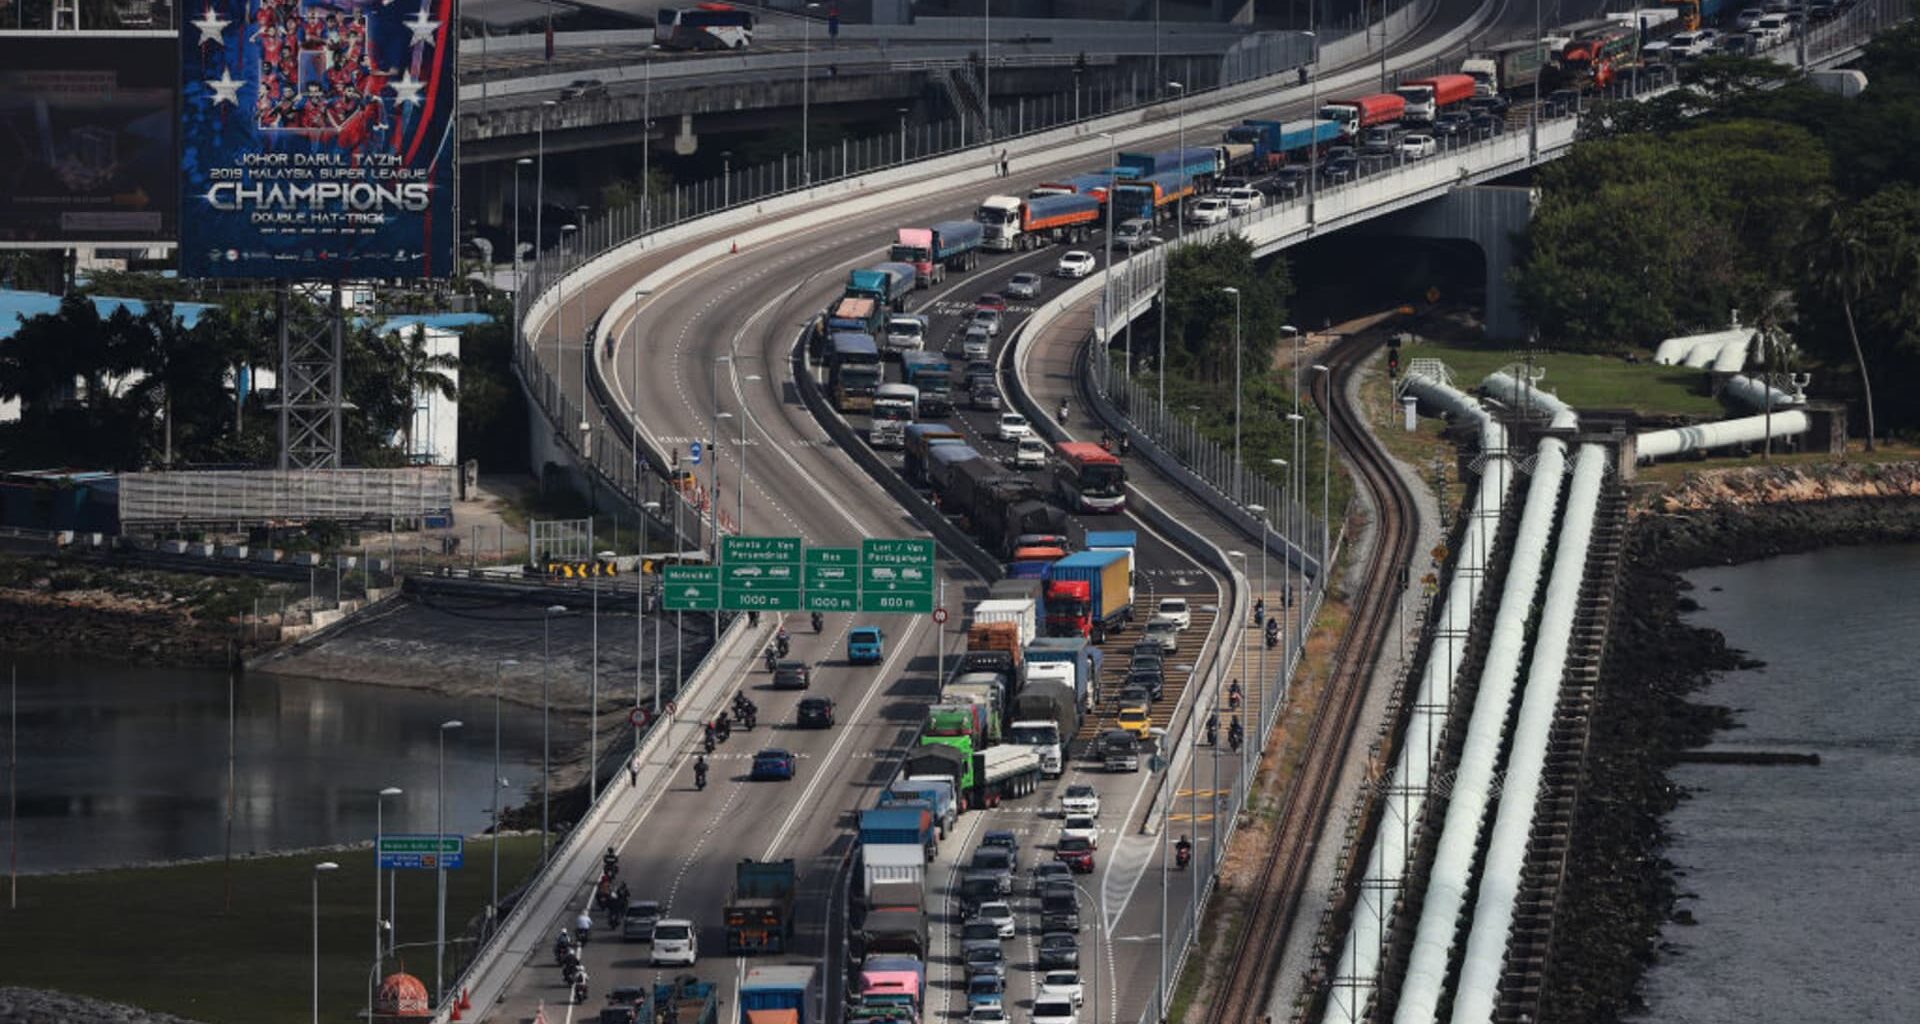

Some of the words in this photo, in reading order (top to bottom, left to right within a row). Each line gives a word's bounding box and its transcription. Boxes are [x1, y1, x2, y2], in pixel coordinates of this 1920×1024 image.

[235, 153, 287, 166] JOHOR
[294, 153, 347, 166] DARUL
[354, 153, 403, 166] TA'ZIM
[209, 168, 242, 179] 2019
[248, 168, 314, 179] MALAYSIA
[319, 168, 365, 179] SUPER
[370, 168, 428, 179] LEAGUE
[207, 182, 430, 211] CHAMPIONS
[251, 212, 306, 223] DOUBLE
[311, 212, 385, 224] HAT-TRICK
[778, 541, 794, 550] Van
[873, 544, 892, 552] Lori
[906, 544, 924, 552] Van
[739, 595, 767, 605] 1000
[770, 597, 780, 605] m
[811, 597, 839, 607] 1000
[841, 599, 851, 607] m
[880, 597, 903, 607] 800
[904, 599, 915, 607] m
